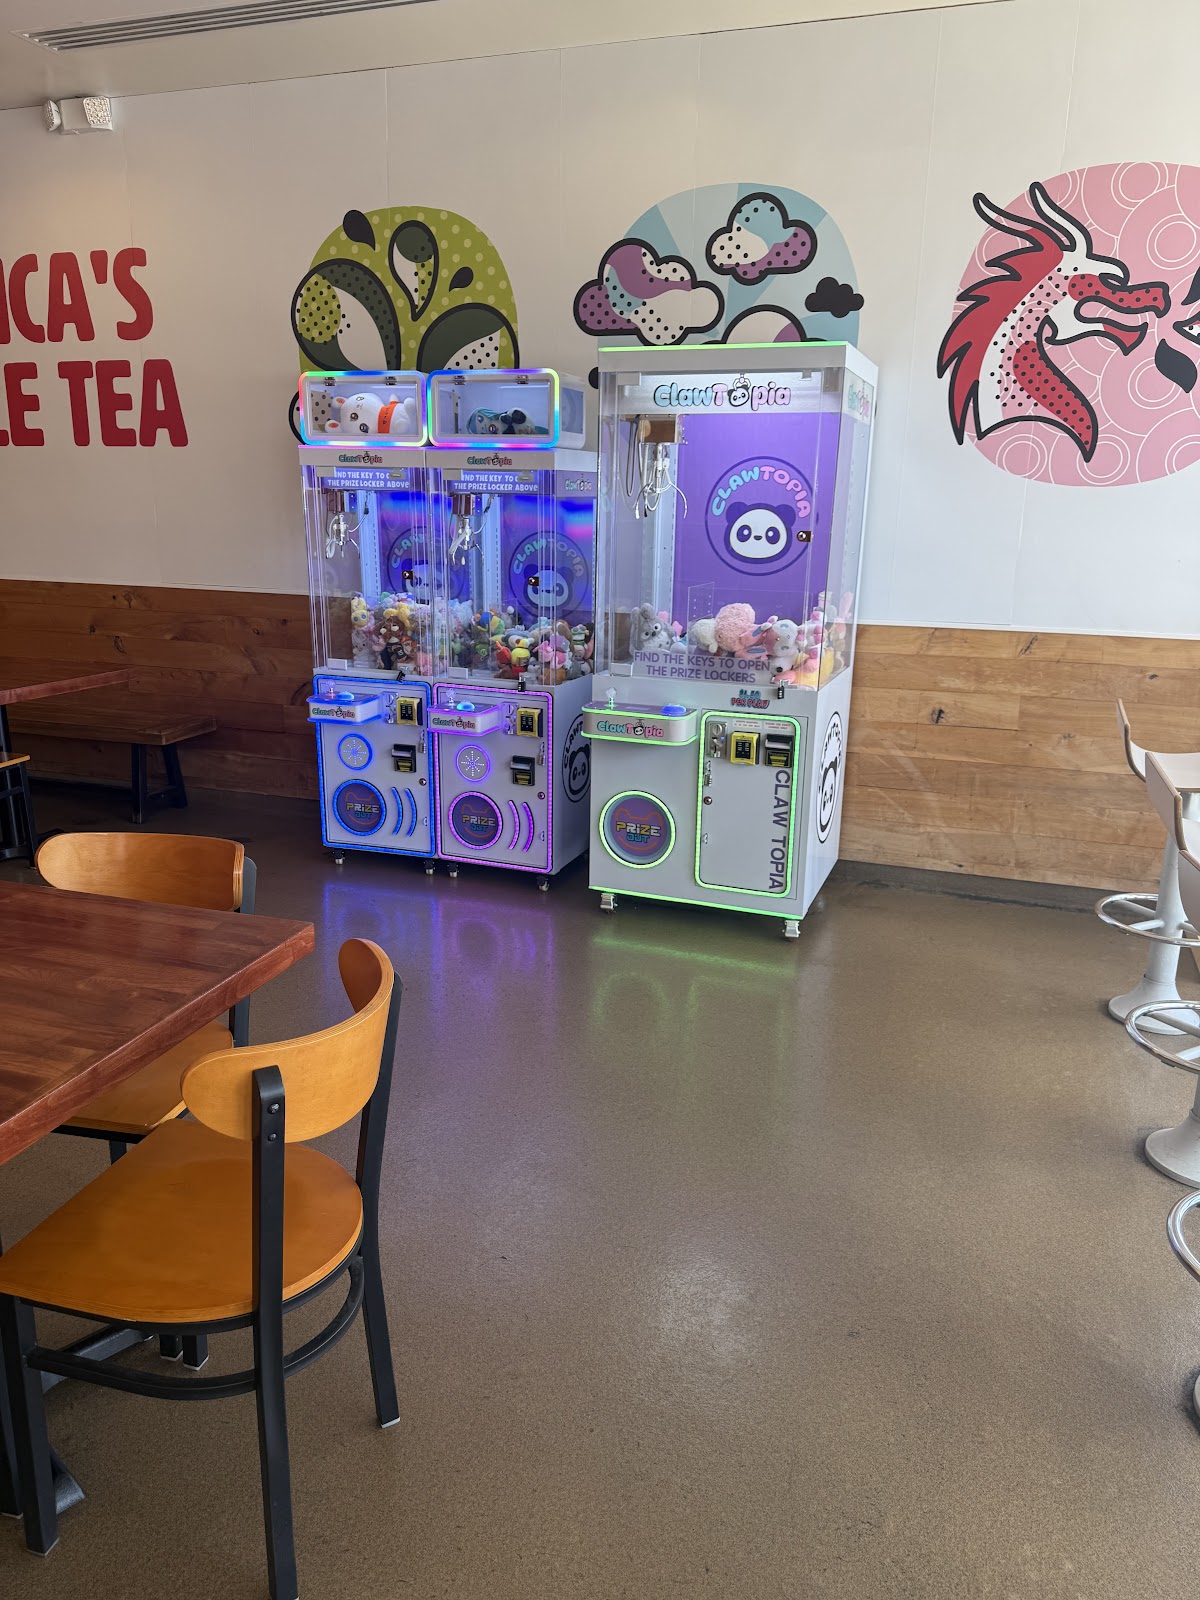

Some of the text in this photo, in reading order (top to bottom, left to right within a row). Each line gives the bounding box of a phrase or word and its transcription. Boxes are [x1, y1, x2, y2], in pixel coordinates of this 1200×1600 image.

[57, 358, 189, 447] TEA
[653, 381, 792, 412] ClawTopia
[338, 453, 383, 465] ClawTopia
[467, 455, 513, 467] ClawTopia
[347, 471, 360, 479] THE
[360, 471, 373, 479] KEY
[475, 474, 489, 482] THE
[489, 474, 503, 482] KEY
[505, 475, 514, 483] TO
[327, 479, 340, 487] THE
[340, 479, 359, 487] PRIZE
[454, 482, 467, 490] THE
[467, 482, 487, 490] PRIZE
[487, 483, 513, 491] LOCKER
[710, 465, 812, 518] CLAWTOPIA
[634, 651, 771, 671] FIND THE KEYS TO OPEN
[646, 664, 756, 683] THE PRIZE LOCKERS
[731, 697, 770, 709] PER PLAY
[597, 721, 665, 738] ClawTopia
[768, 769, 791, 889] CLAW TOPIA
[626, 833, 650, 843] OUT
